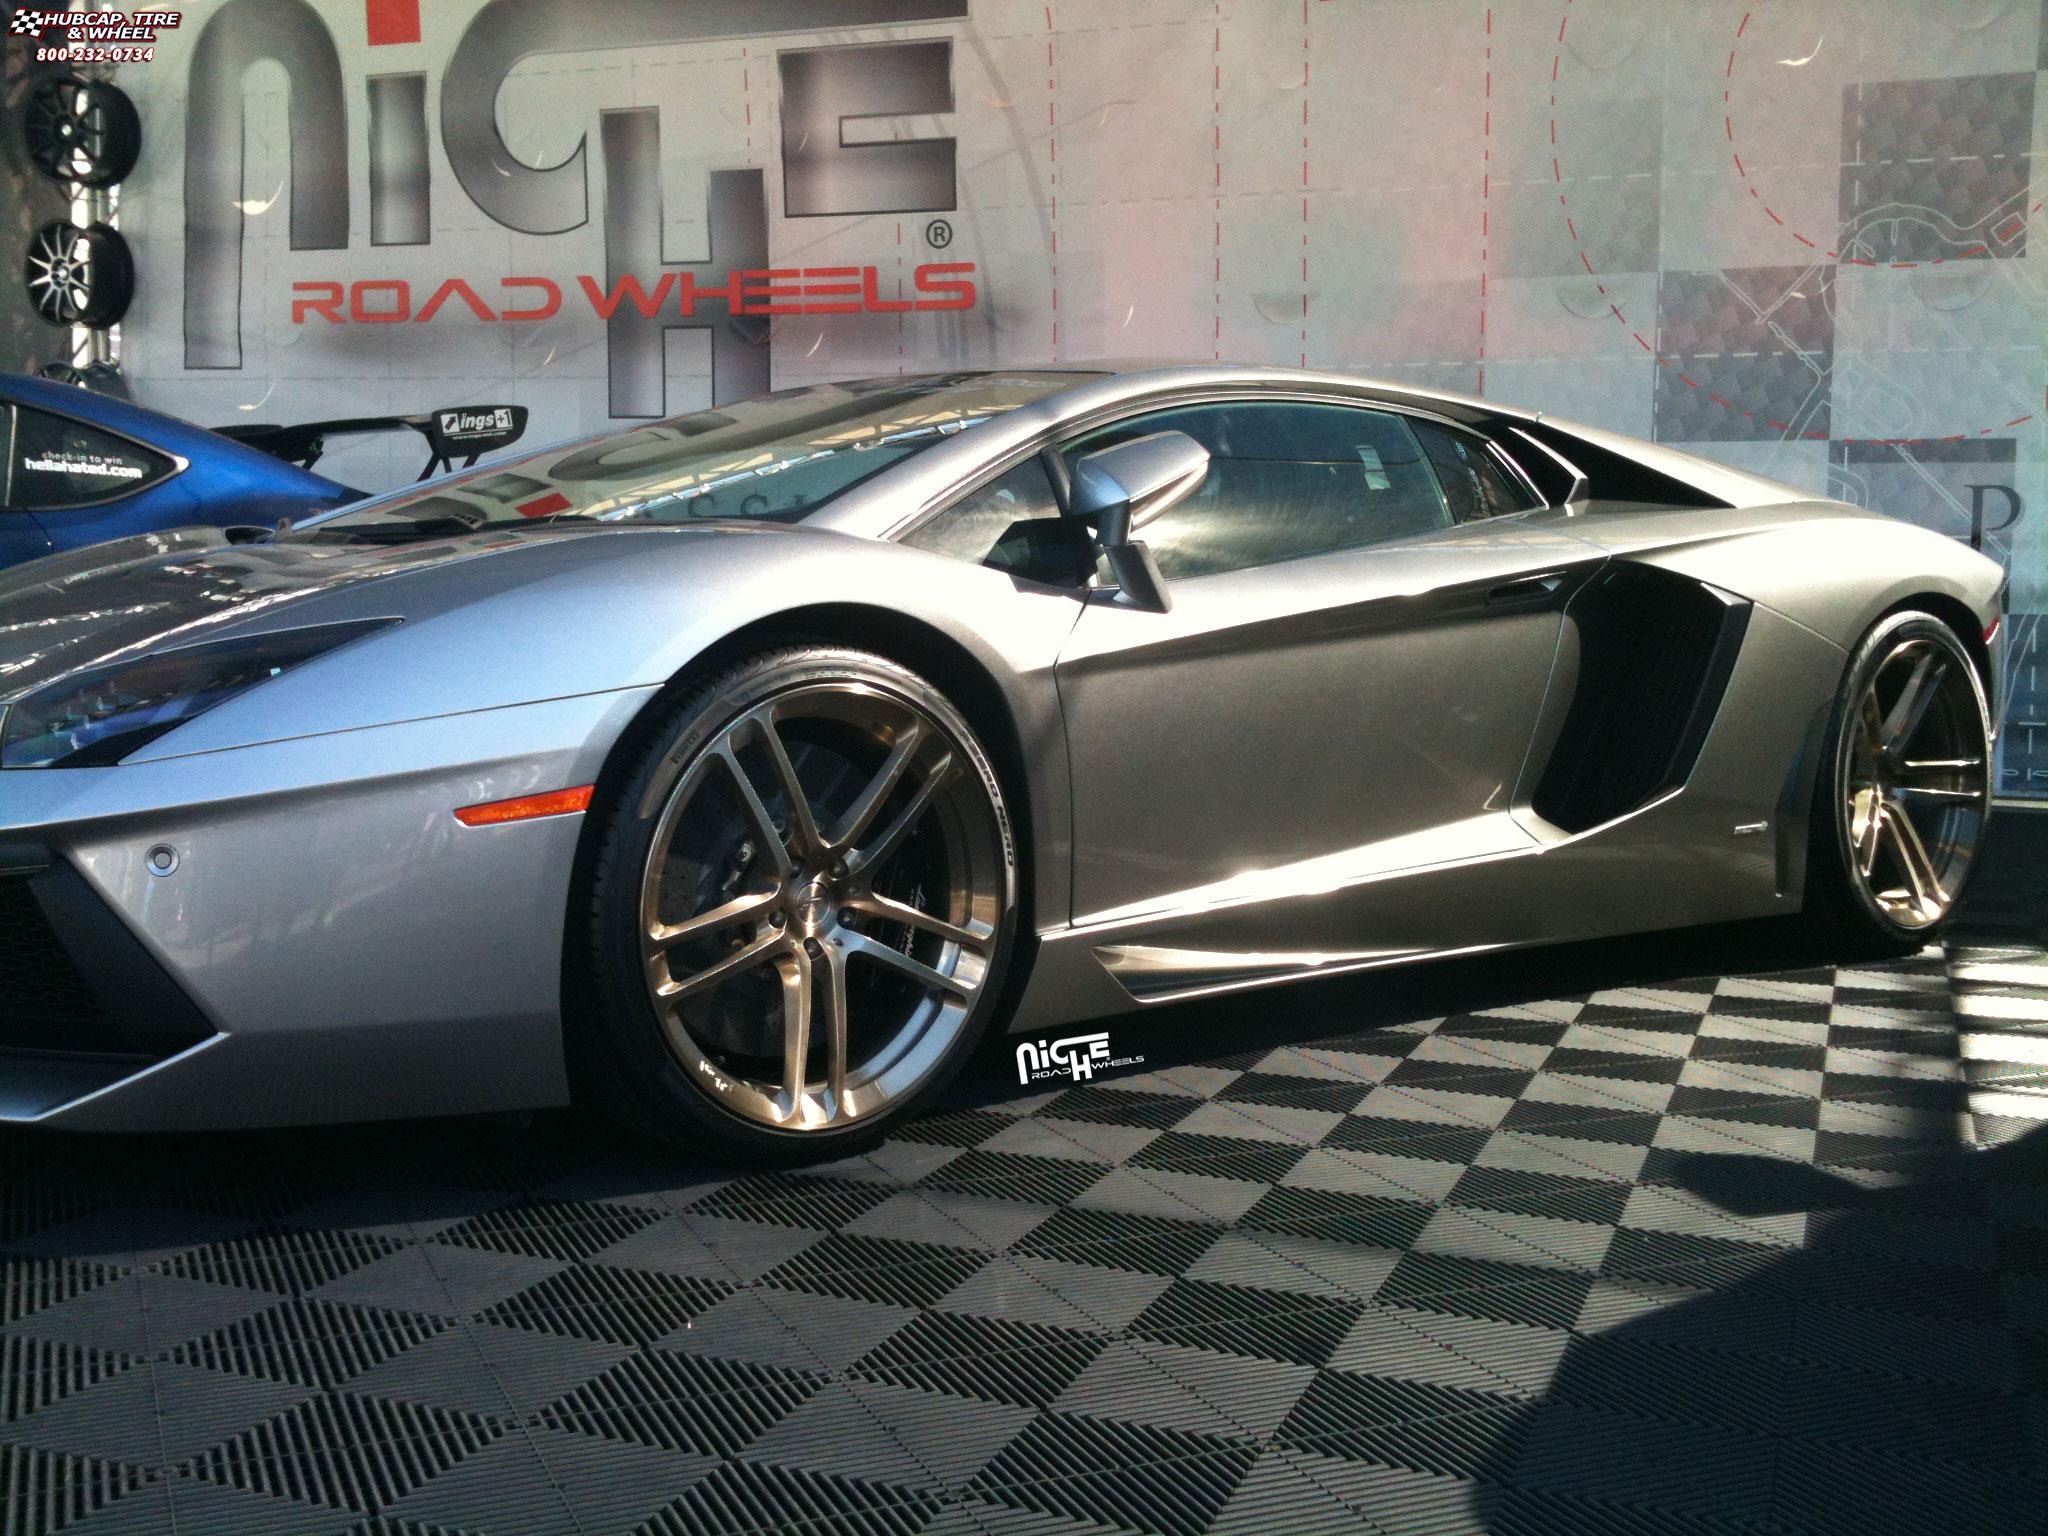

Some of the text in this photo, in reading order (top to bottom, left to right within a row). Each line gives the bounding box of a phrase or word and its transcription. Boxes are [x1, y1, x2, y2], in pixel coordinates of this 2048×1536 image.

[292, 262, 976, 324] ROAD WHEELS
[24, 457, 143, 478] hellahated.com
[89, 455, 102, 463] to
[104, 456, 123, 465] win
